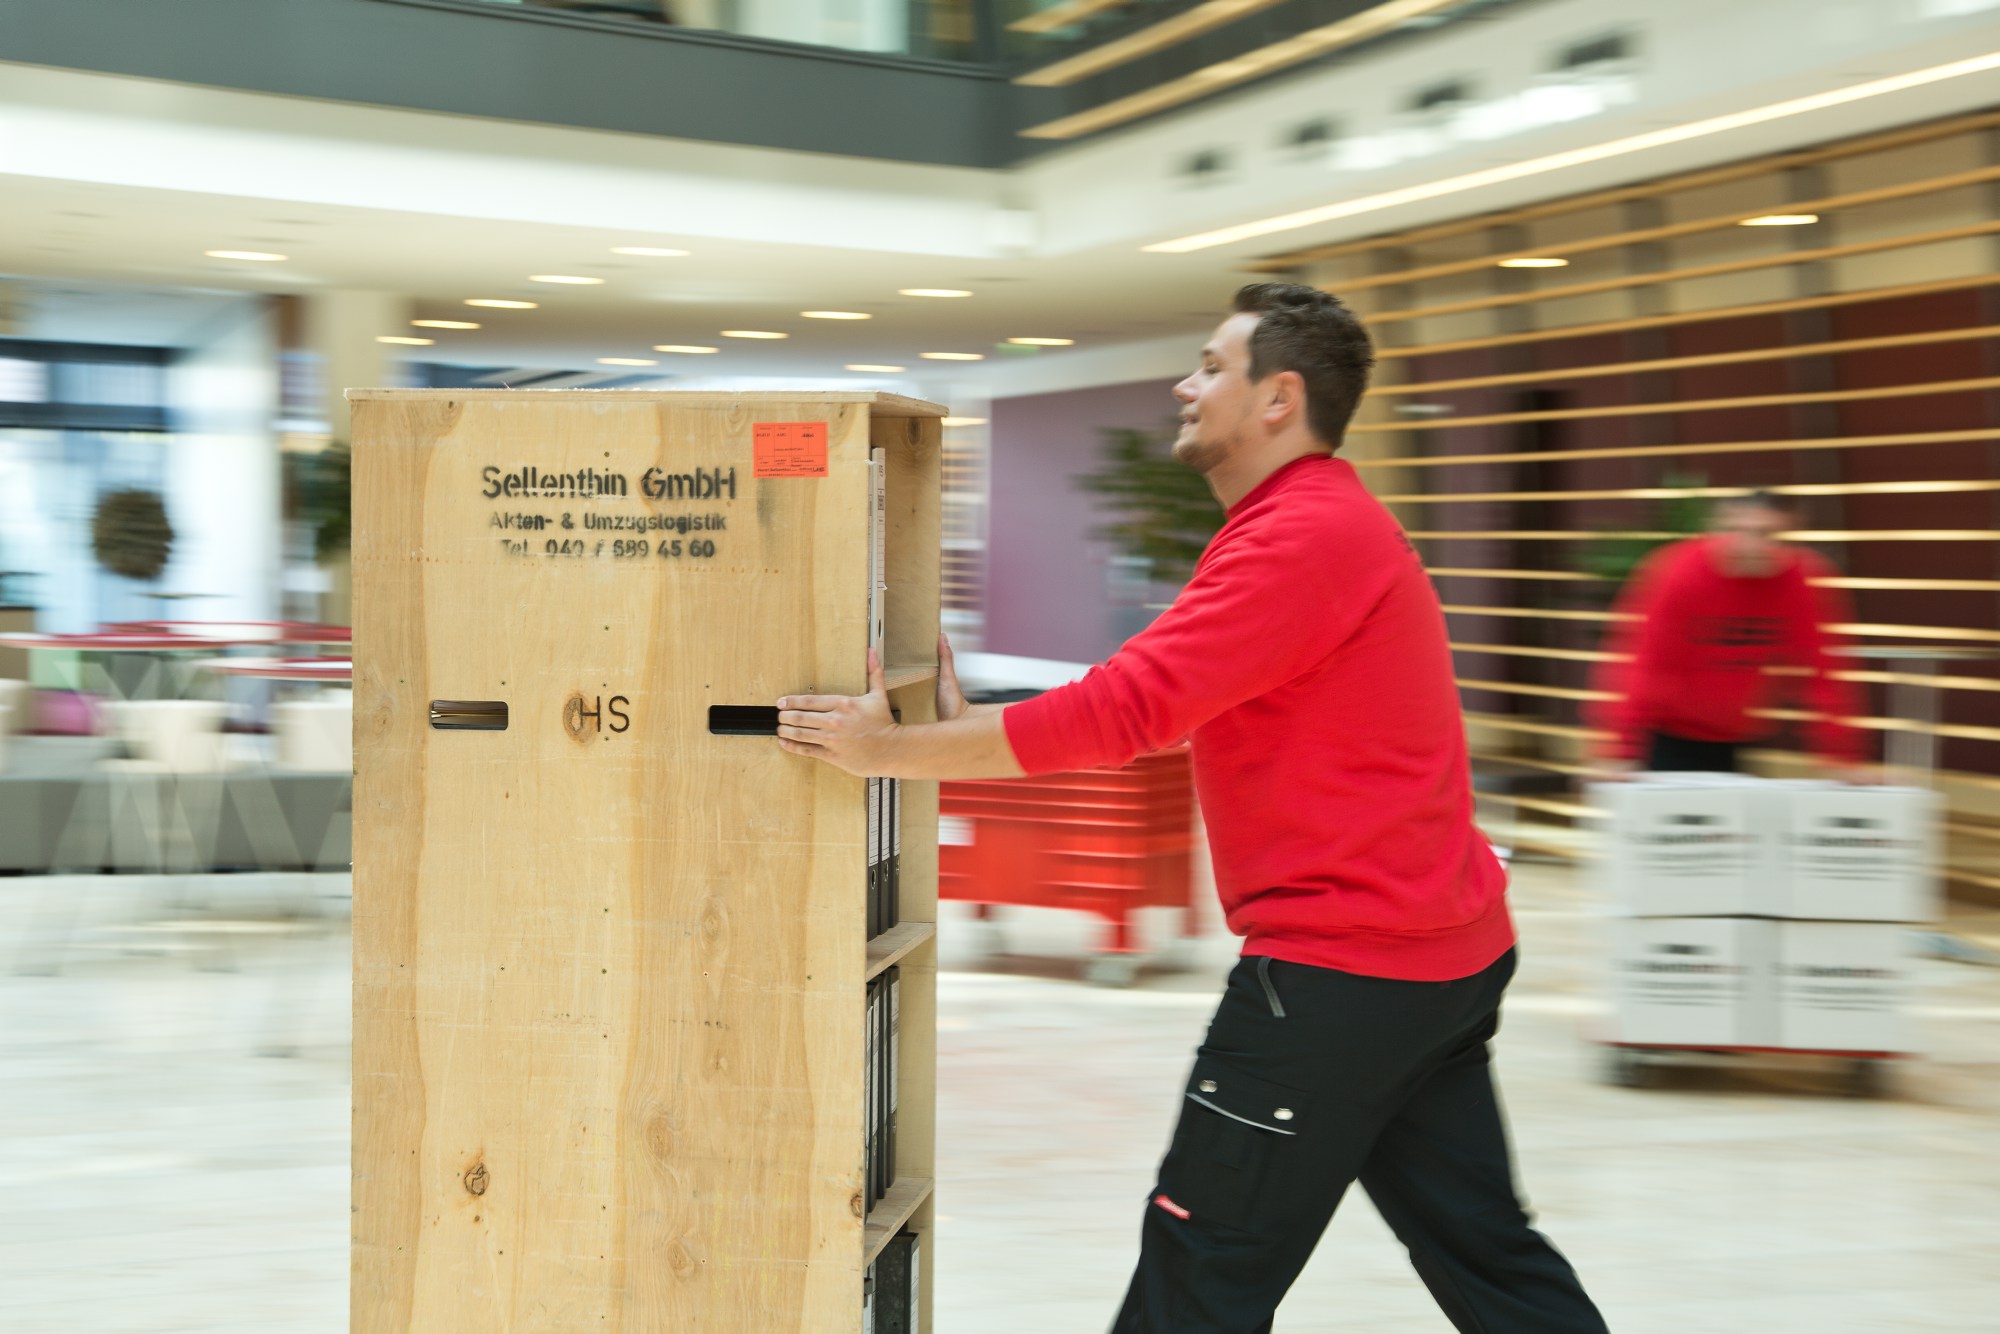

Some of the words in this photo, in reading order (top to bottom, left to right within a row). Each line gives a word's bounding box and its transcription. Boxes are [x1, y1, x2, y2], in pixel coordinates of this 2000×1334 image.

[482, 466, 627, 498] Sellenthin
[642, 467, 736, 499] GmbH
[490, 511, 553, 530] Akten-
[561, 512, 575, 530] &
[584, 513, 727, 534] Umzugslogistik
[614, 539, 649, 557] 689
[658, 540, 682, 558] 45
[690, 540, 715, 558] 60
[580, 696, 630, 733] HS
